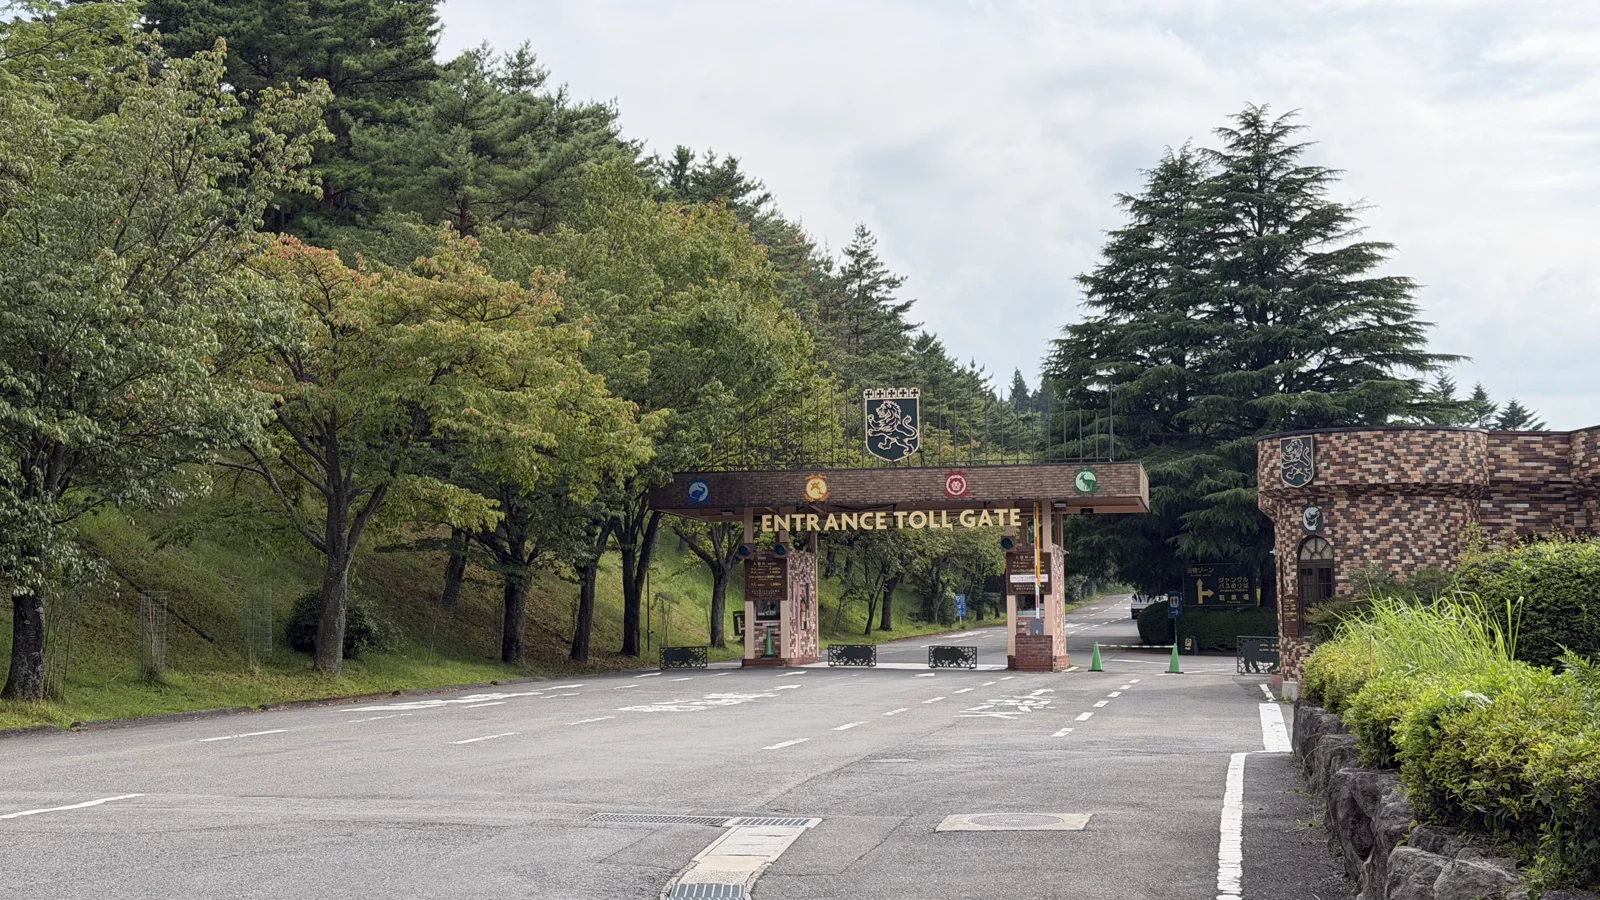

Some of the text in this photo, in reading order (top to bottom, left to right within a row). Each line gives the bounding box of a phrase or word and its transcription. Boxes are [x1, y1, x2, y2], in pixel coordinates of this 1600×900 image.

[762, 508, 1022, 532] ENTRANCE TOLL GATE
